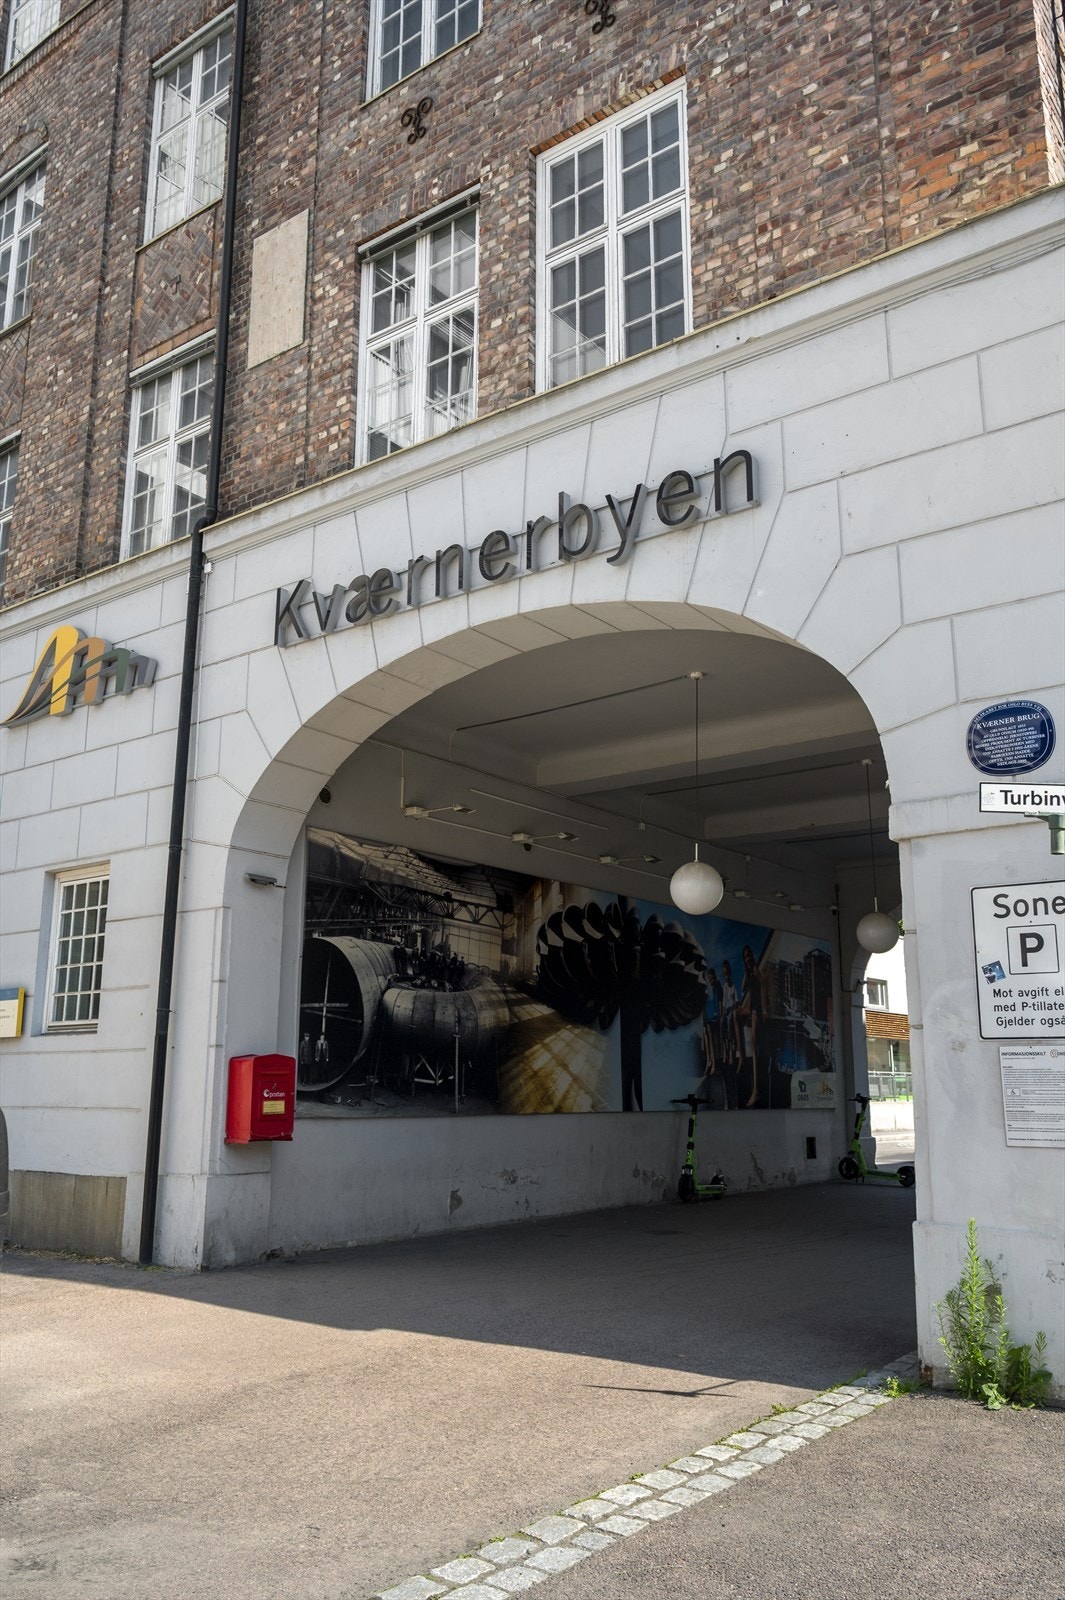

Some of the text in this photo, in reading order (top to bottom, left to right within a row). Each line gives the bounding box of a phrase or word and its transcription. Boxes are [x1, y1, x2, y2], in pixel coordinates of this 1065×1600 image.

[275, 449, 761, 648] Kværnerbyen
[977, 713, 1040, 730] KVÆRNER BRUG
[993, 893, 1065, 918] Sone
[1020, 932, 1045, 967] P
[993, 988, 1013, 998] Mot
[1018, 987, 1049, 999] avgift
[994, 1001, 1064, 1012] med P-tillate
[996, 1016, 1035, 1028] Gjelder
